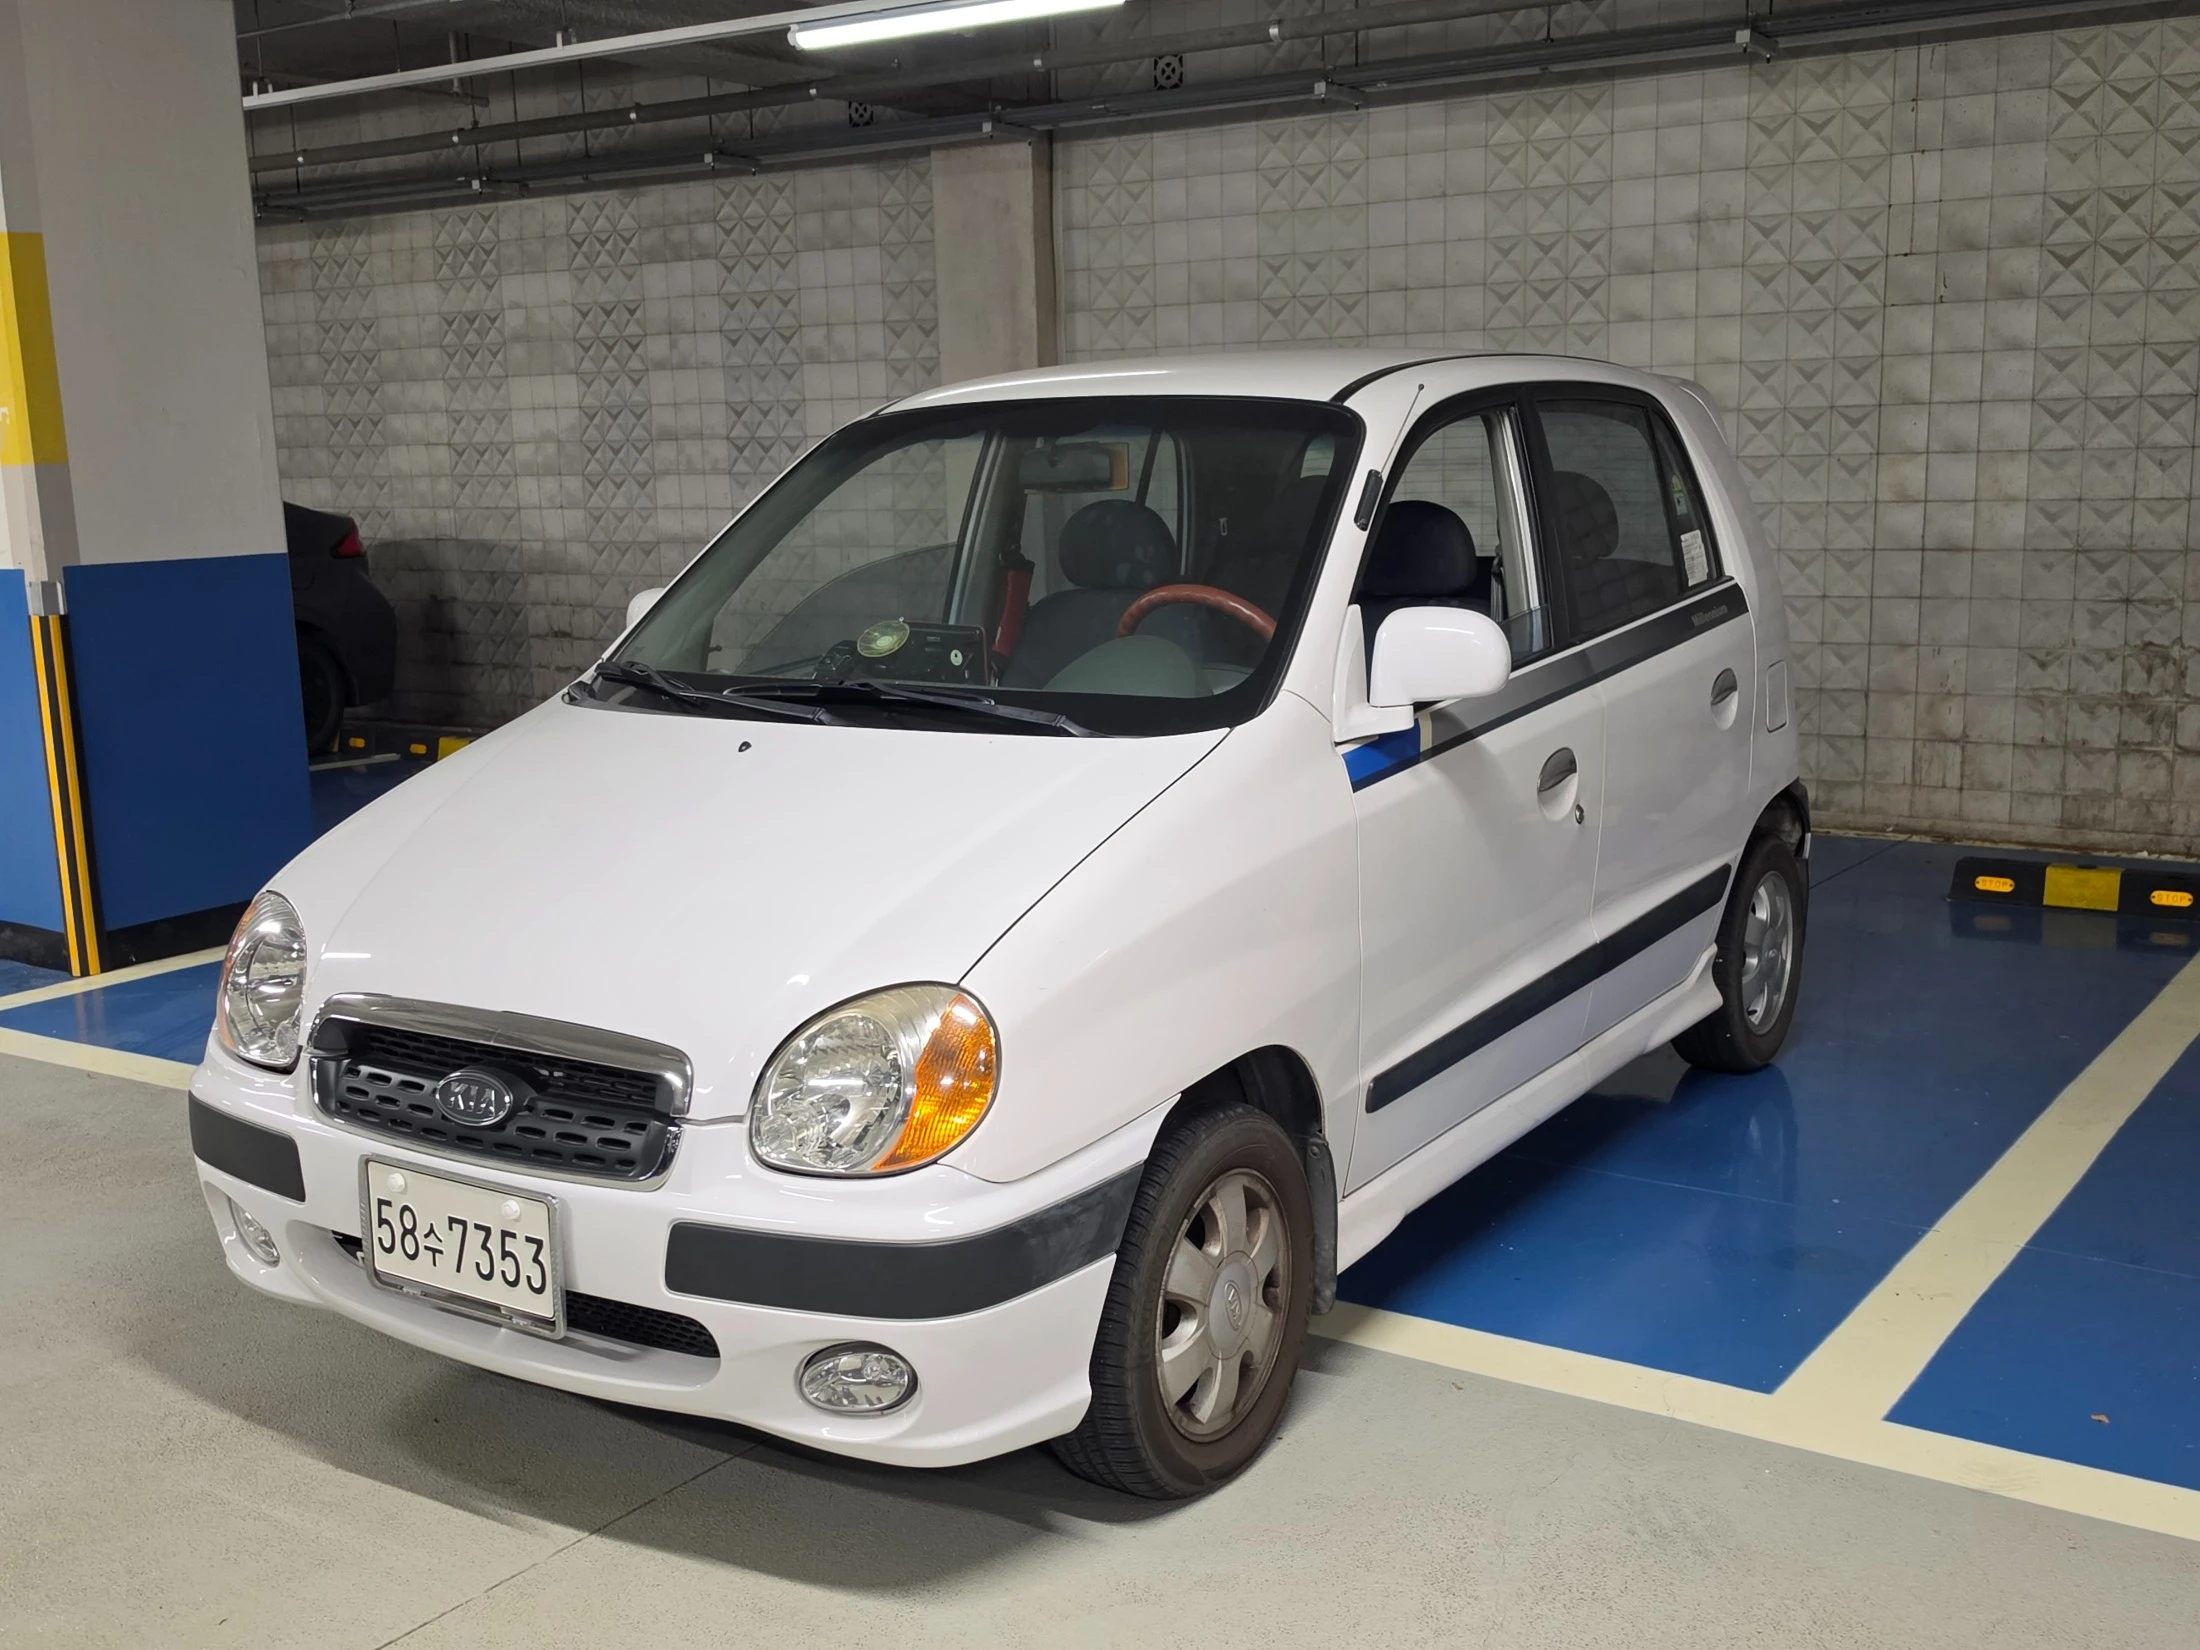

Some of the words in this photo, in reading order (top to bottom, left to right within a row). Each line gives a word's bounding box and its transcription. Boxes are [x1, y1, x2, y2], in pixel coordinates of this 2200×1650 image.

[2157, 893, 2187, 904] STOP
[447, 1081, 495, 1117] KIA
[377, 1198, 547, 1295] 58수7353
